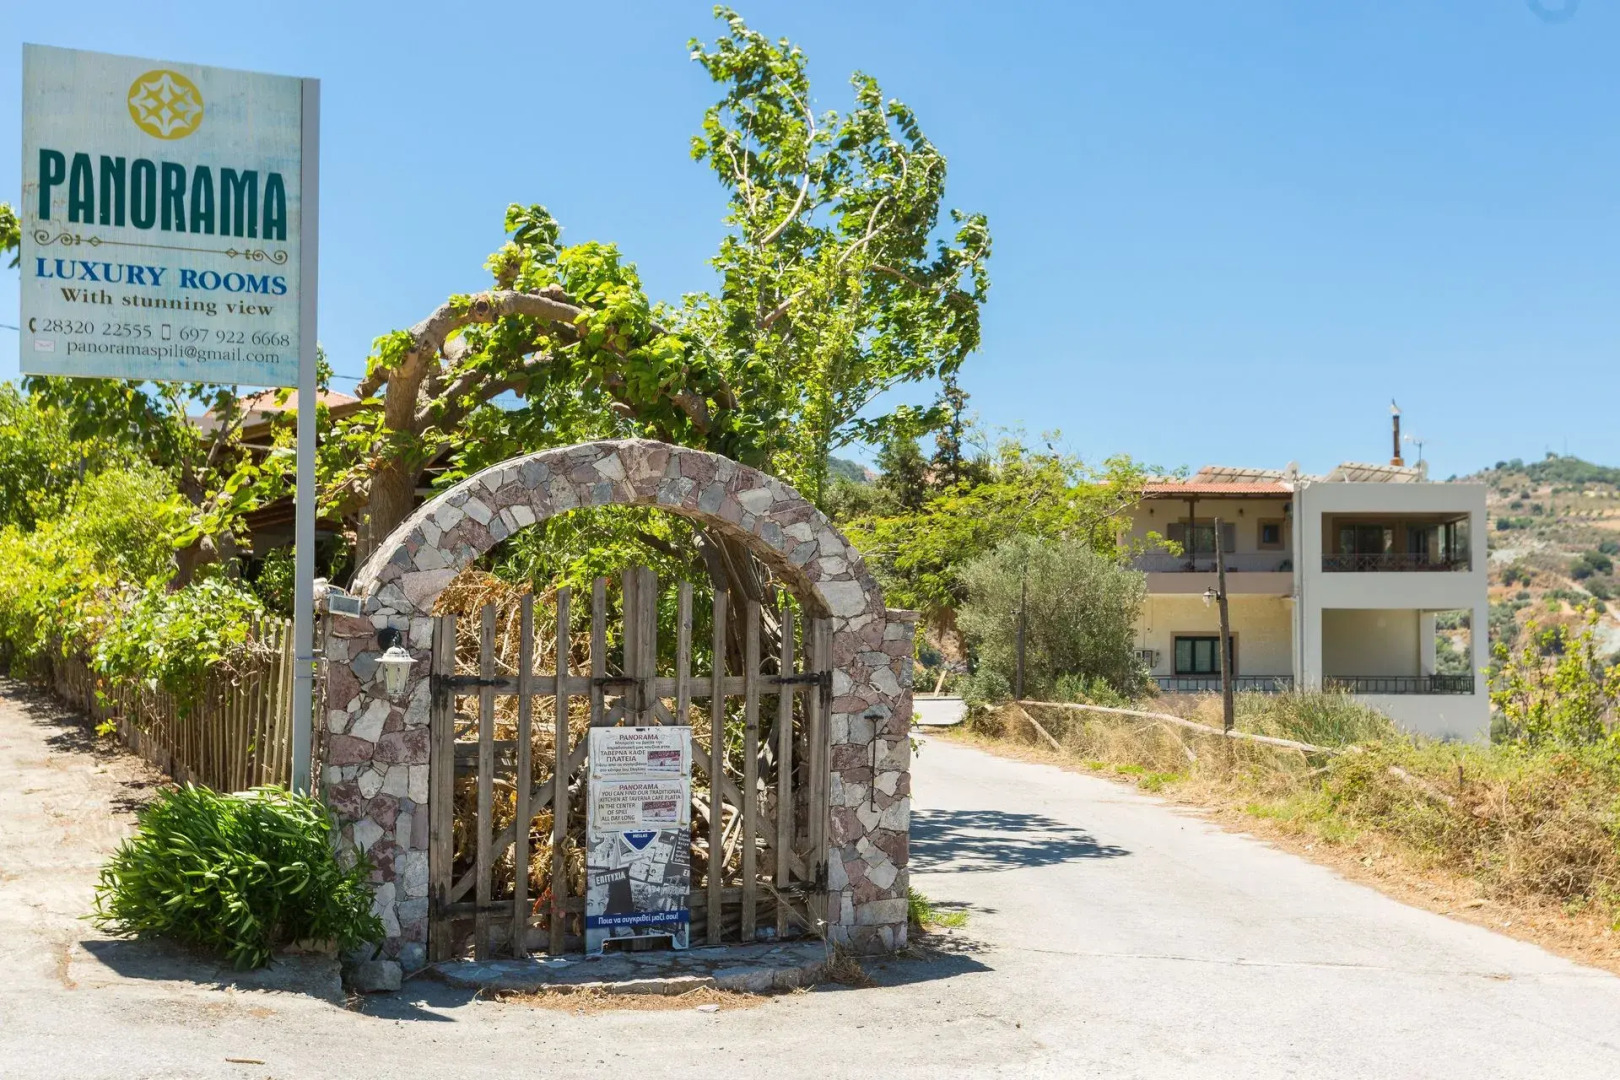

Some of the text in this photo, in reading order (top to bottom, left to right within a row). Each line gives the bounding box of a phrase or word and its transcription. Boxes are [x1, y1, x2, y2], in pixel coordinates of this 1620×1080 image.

[38, 148, 288, 242] PANORAMA
[35, 257, 287, 296] LUXURY ROOMS
[61, 287, 274, 316] With stunning view
[43, 318, 290, 347] 28320 22555 697 922 6668
[67, 341, 280, 363] panoramaspili@gmail.com
[651, 912, 665, 922] μαζί
